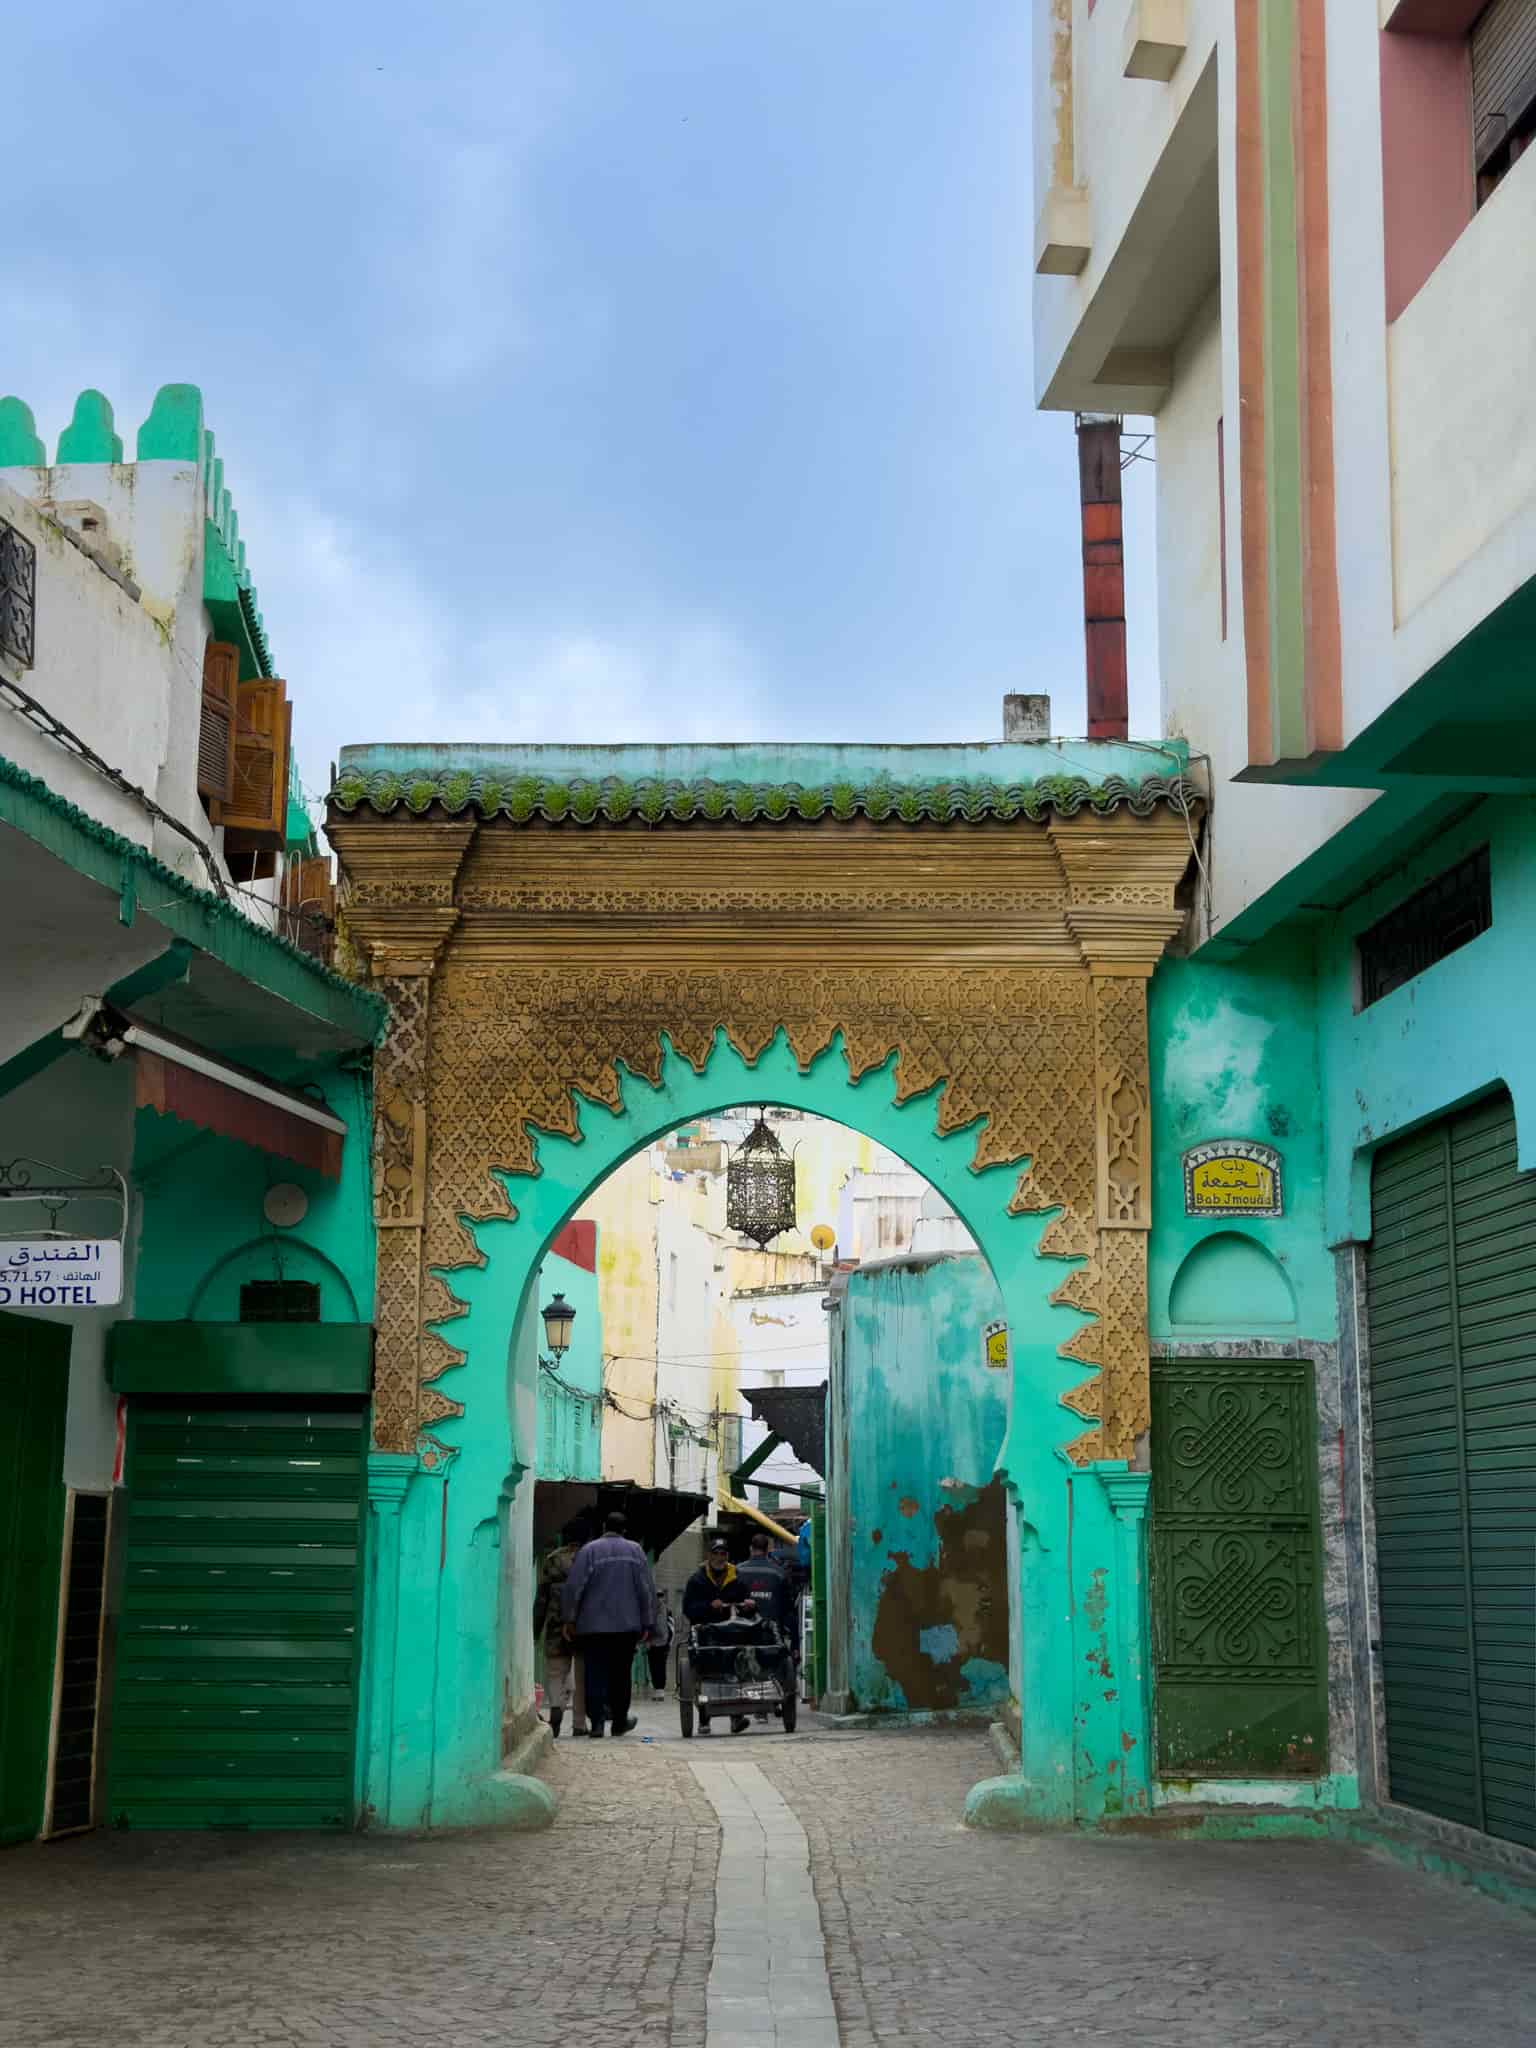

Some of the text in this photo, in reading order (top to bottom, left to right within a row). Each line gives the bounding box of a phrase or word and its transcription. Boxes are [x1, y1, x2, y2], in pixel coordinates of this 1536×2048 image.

[1221, 1160, 1245, 1174] باب
[1196, 1193, 1221, 1205] Bab
[8, 1244, 100, 1266] الفندق
[63, 1271, 101, 1281] الهاتف
[20, 1285, 97, 1305] HOTEL
